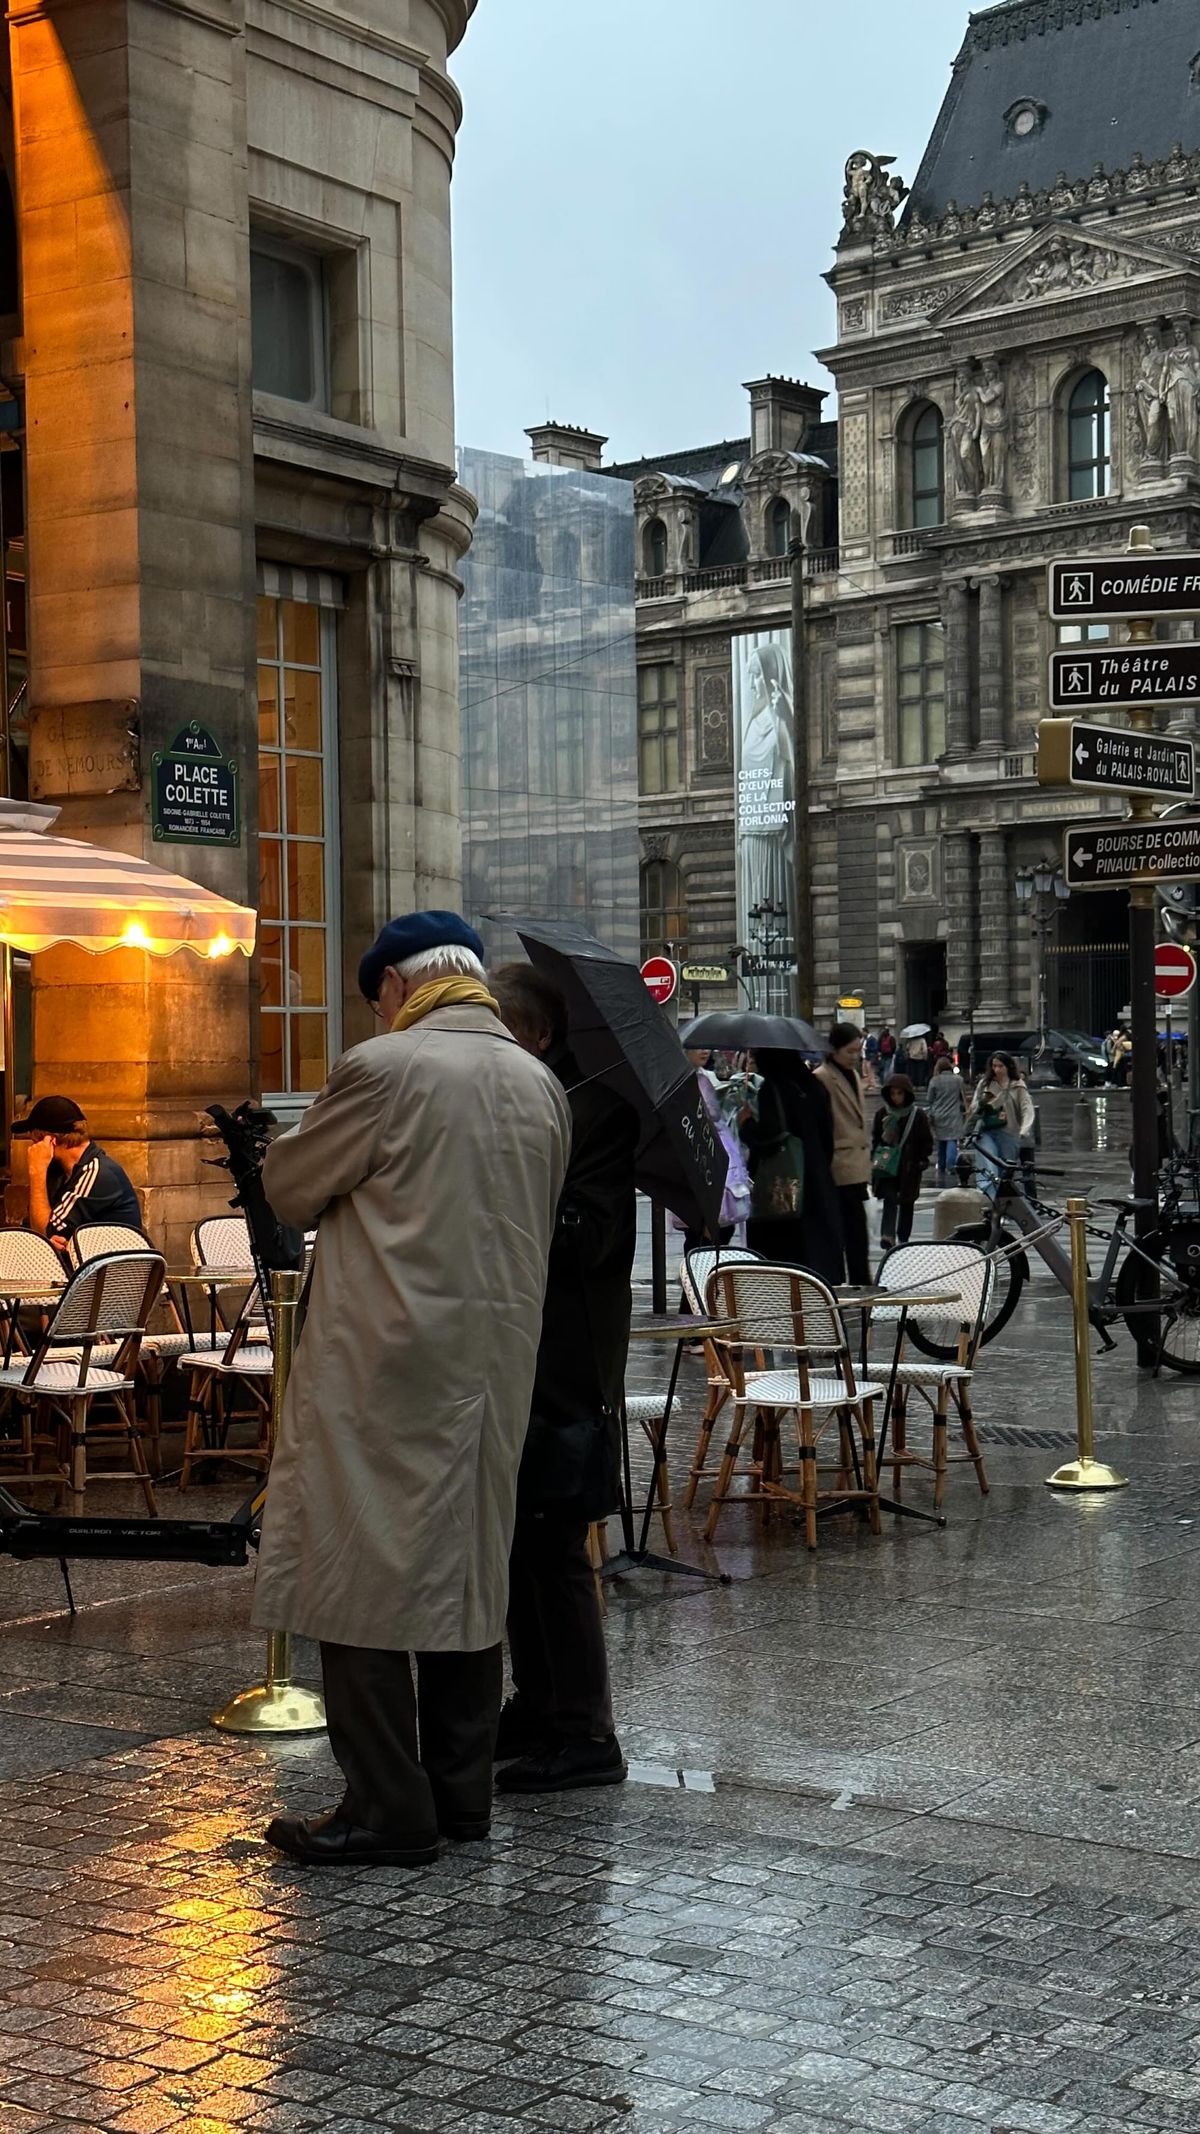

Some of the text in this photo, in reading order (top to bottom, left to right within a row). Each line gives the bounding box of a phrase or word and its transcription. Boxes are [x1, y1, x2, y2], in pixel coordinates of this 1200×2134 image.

[1100, 574, 1179, 595] COMÉDIE
[1100, 658, 1169, 674] Théâtre
[1099, 675, 1198, 696] du PALAIS
[1096, 737, 1175, 763] Galerie et Jardin
[58, 753, 125, 776] NEMOURS
[174, 763, 218, 785] PLACE
[738, 767, 773, 780] CHEFS-
[1096, 760, 1107, 775] du
[165, 784, 228, 806] COLETTE
[738, 791, 767, 804] DE LA
[209, 811, 231, 820] COLETTE
[738, 813, 789, 826] TORLONIA
[1096, 830, 1200, 853] BOURSE DE COMM
[1096, 852, 1200, 874] PINAULT Collectio
